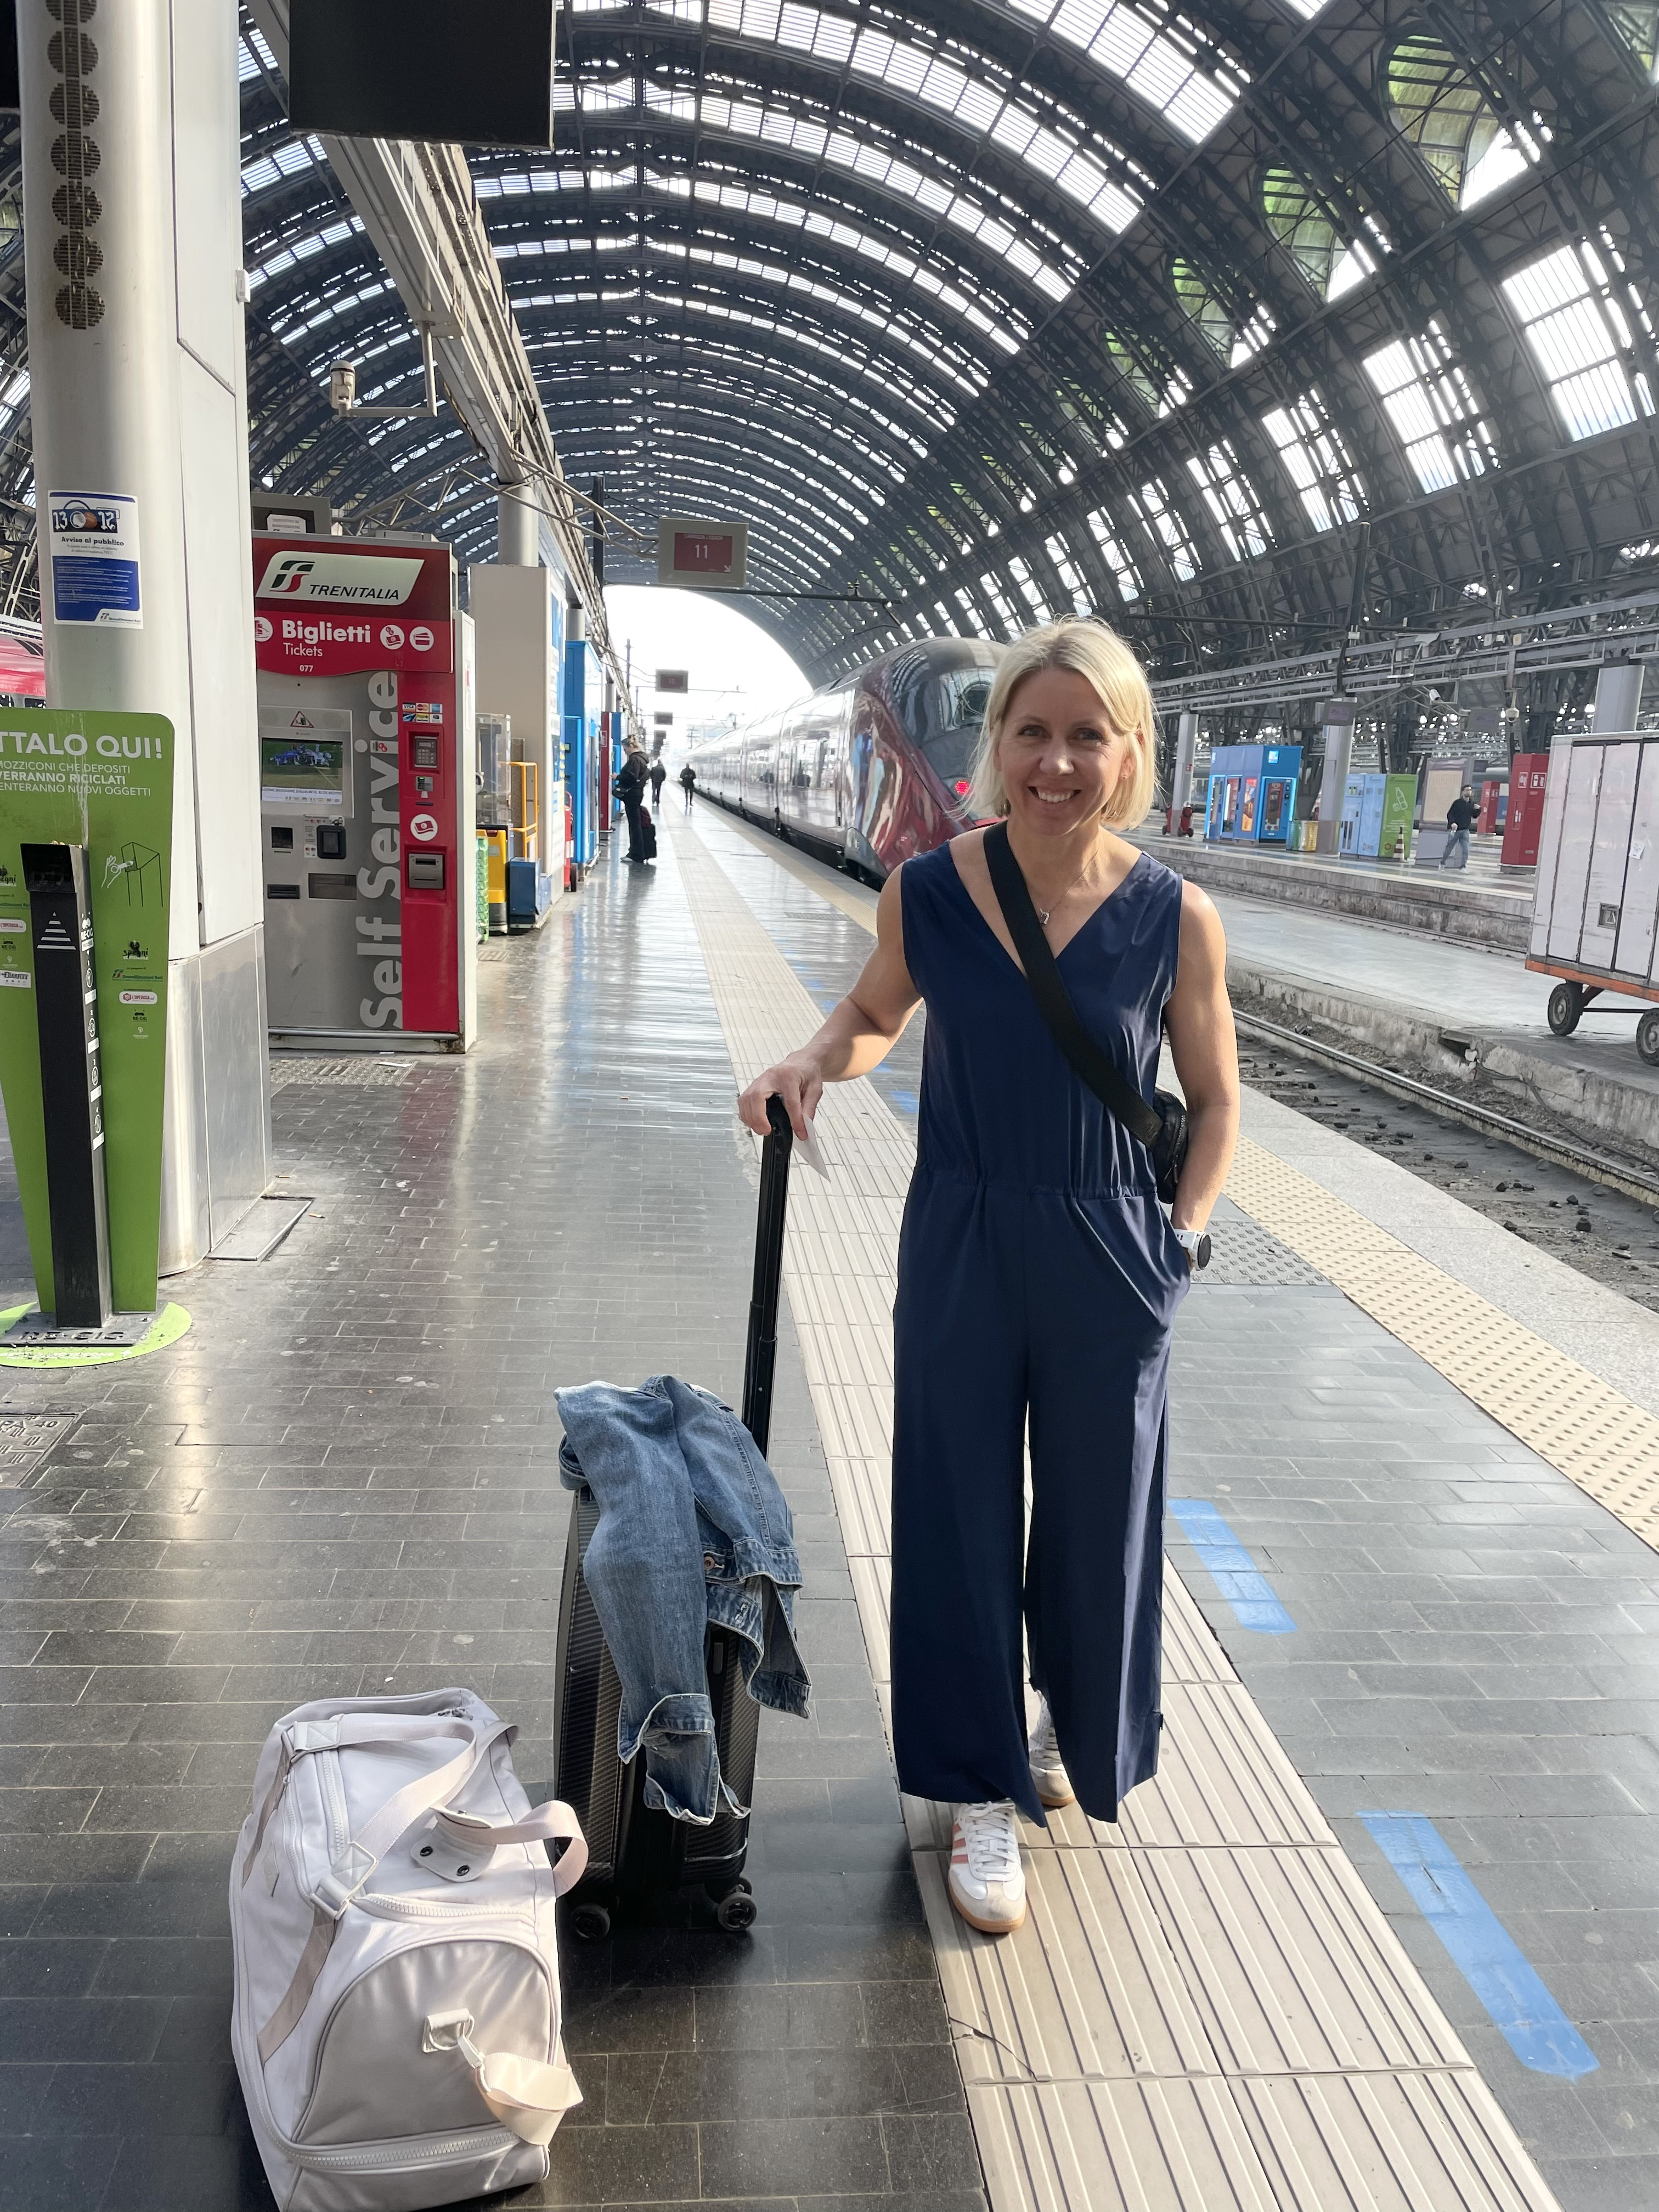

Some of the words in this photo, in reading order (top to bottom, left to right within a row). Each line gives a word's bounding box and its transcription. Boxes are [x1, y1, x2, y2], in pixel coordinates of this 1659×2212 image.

[53, 511, 68, 530] 13
[98, 511, 116, 531] 12
[695, 544, 708, 558] 11
[309, 584, 399, 600] TRENITALIA
[282, 620, 371, 644] Biglietti
[283, 642, 323, 657] Tickets
[300, 664, 313, 673] 077
[96, 735, 162, 759] QUI!
[0, 760, 55, 771] OZZICONI
[59, 763, 80, 772] CHE
[83, 764, 130, 774] DEPOSITI
[70, 774, 126, 785] RICICLATI
[354, 671, 401, 900] Service
[68, 785, 101, 794] NUOVI
[104, 786, 151, 797] OGGETTI
[356, 916, 403, 1029] Self
